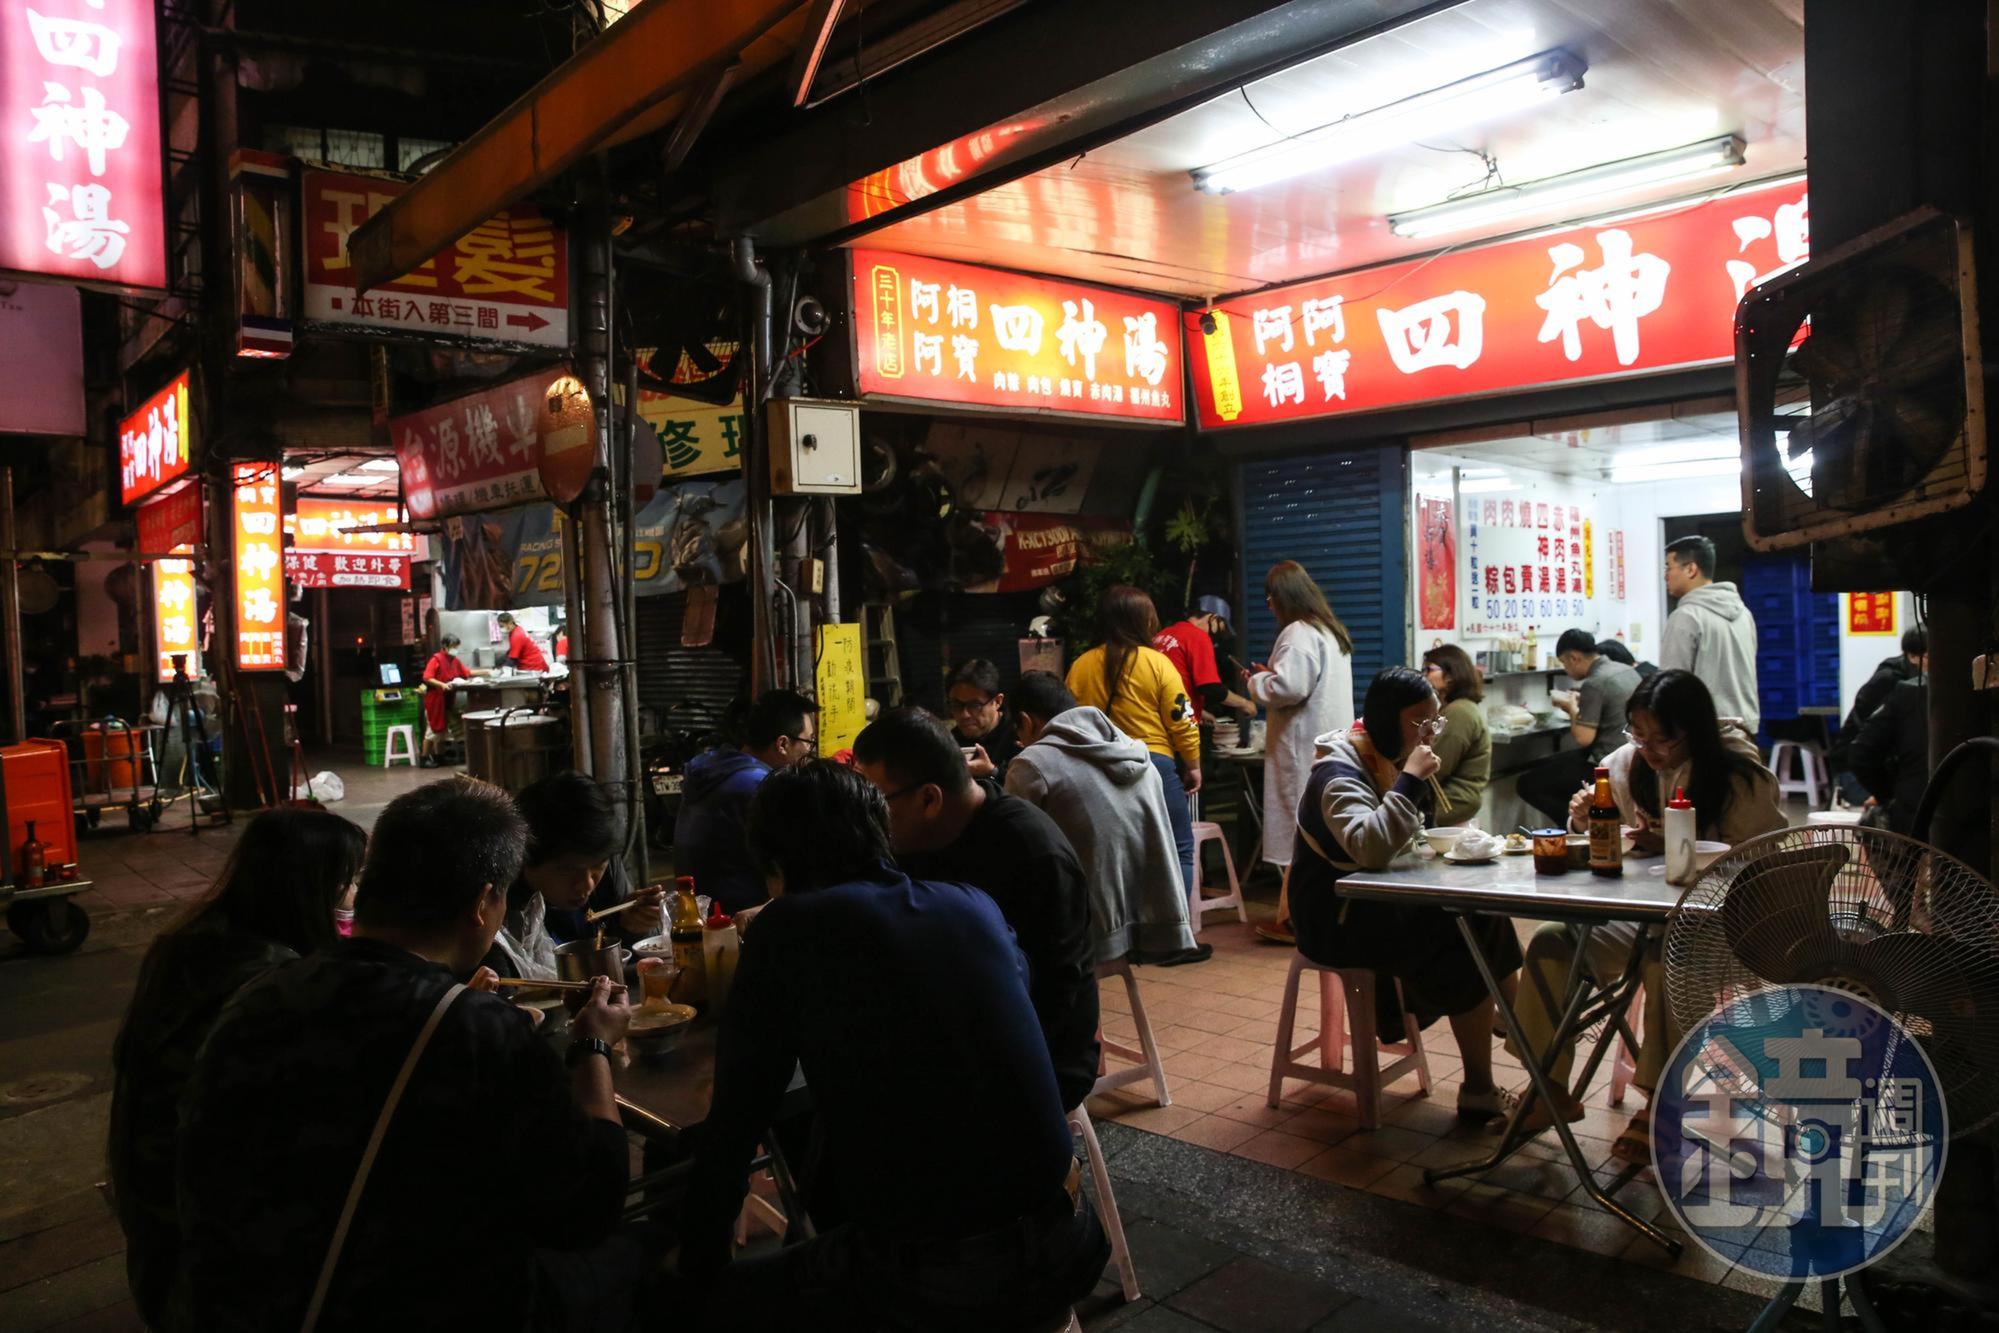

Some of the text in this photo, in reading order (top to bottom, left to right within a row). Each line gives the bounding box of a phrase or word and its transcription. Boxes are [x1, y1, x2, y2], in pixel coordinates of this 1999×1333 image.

[27, 8, 131, 270] 四神湯
[351, 296, 499, 330] 本街入第三間
[878, 274, 898, 372] 三十年老店
[910, 277, 978, 331] 阿桐
[913, 330, 980, 384] 阿寶
[988, 297, 1169, 386] 四神湯
[240, 511, 279, 623] 四神湯
[1486, 599, 1585, 619] 50 20 50 60 50 50
